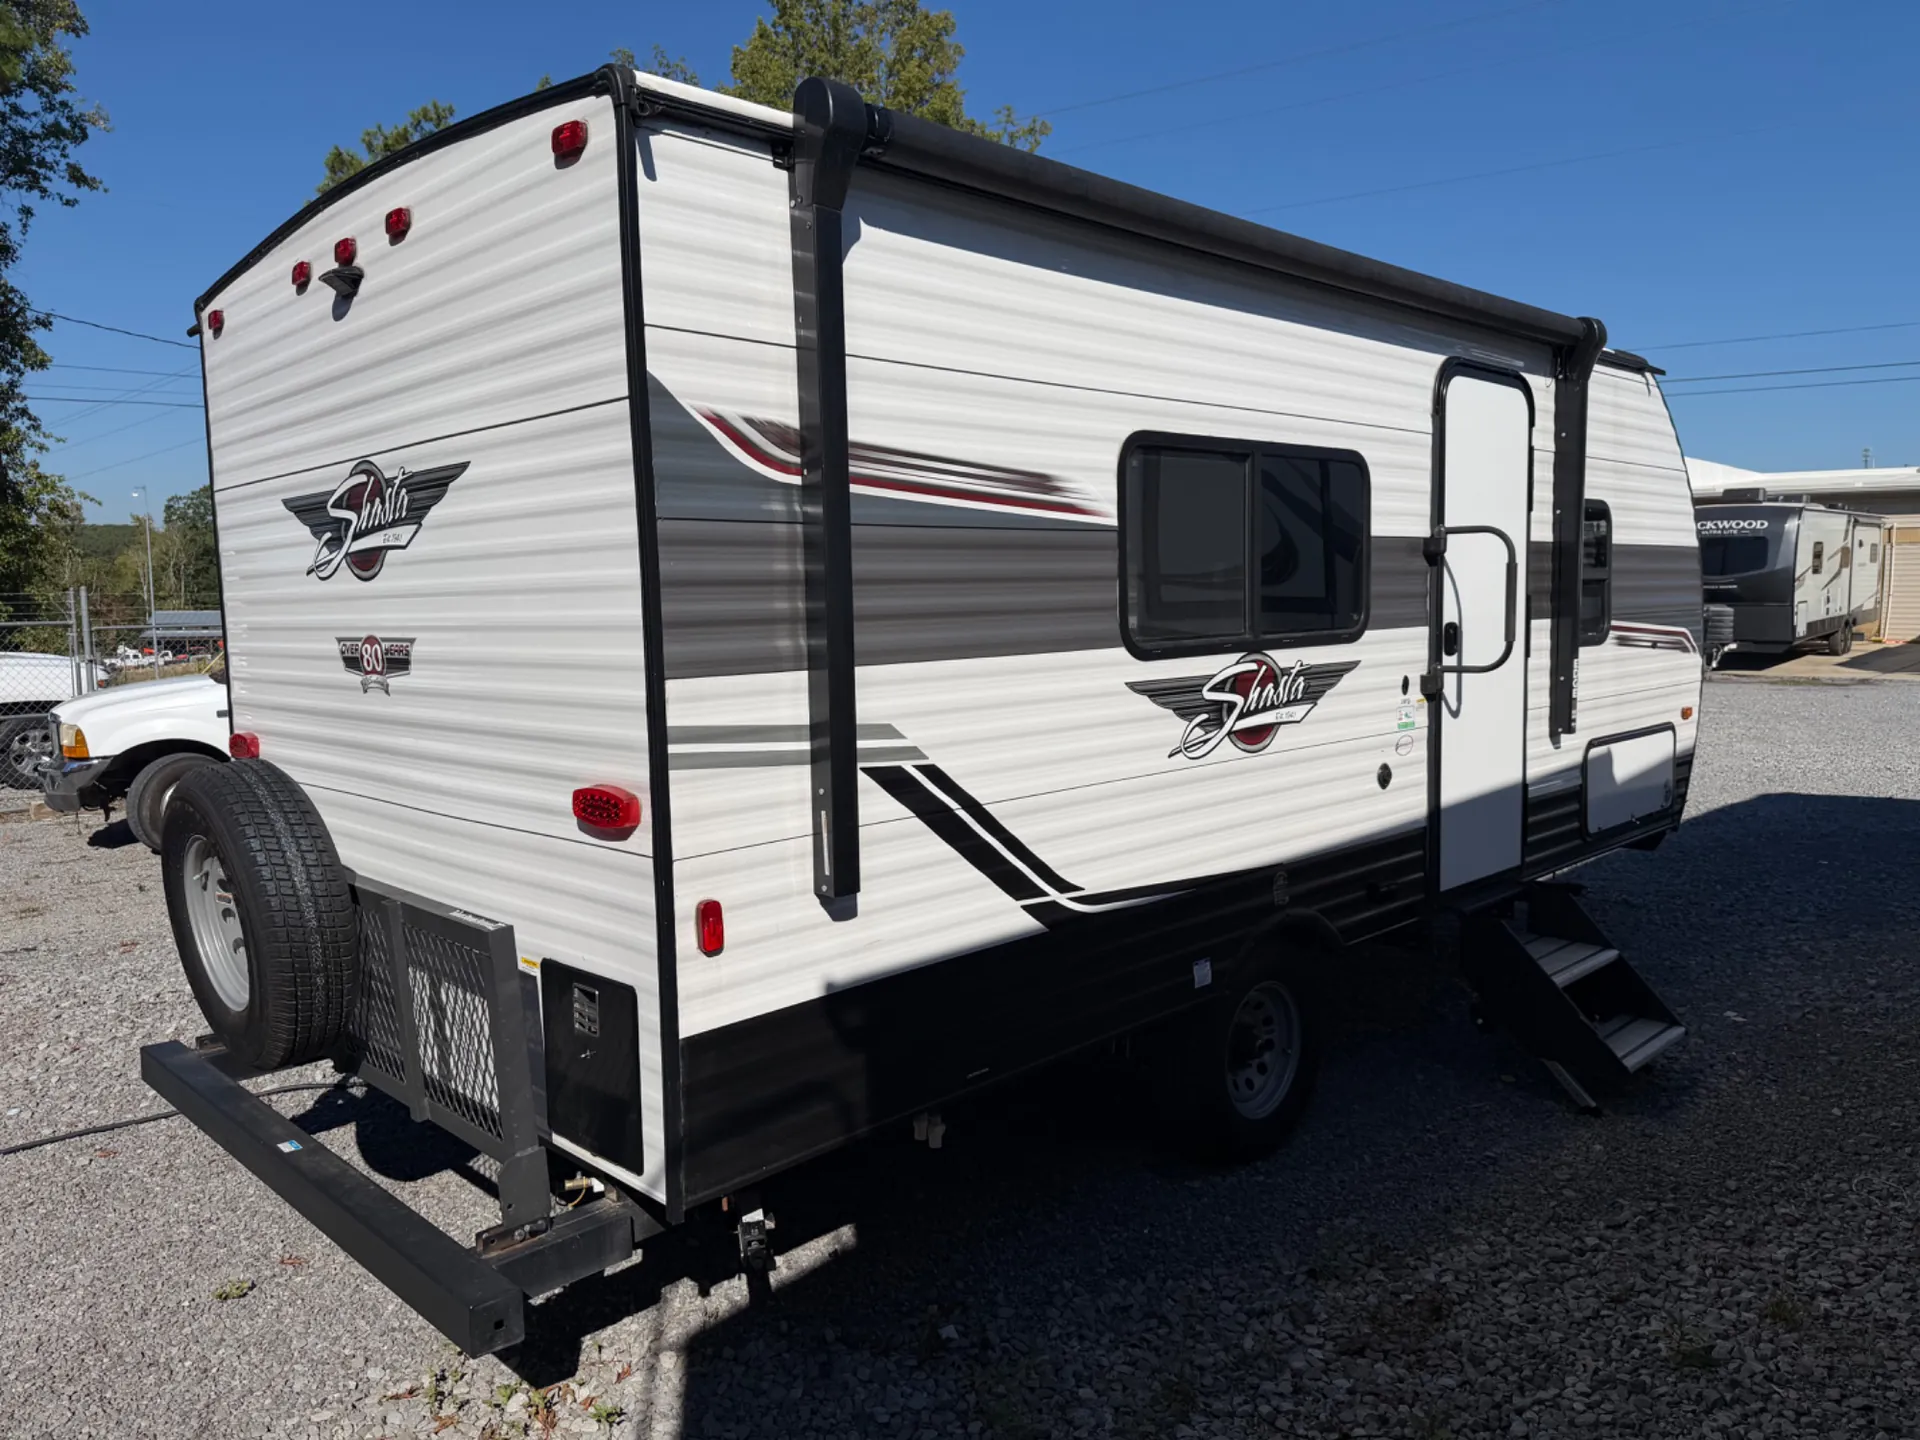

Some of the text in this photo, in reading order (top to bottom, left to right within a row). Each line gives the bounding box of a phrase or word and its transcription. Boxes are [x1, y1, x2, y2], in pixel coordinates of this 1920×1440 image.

[306, 466, 412, 581] Shasta
[1697, 520, 1769, 530] CKWOOD
[341, 643, 410, 671] OVER 80 YEARS
[1168, 660, 1311, 760] Shasta
